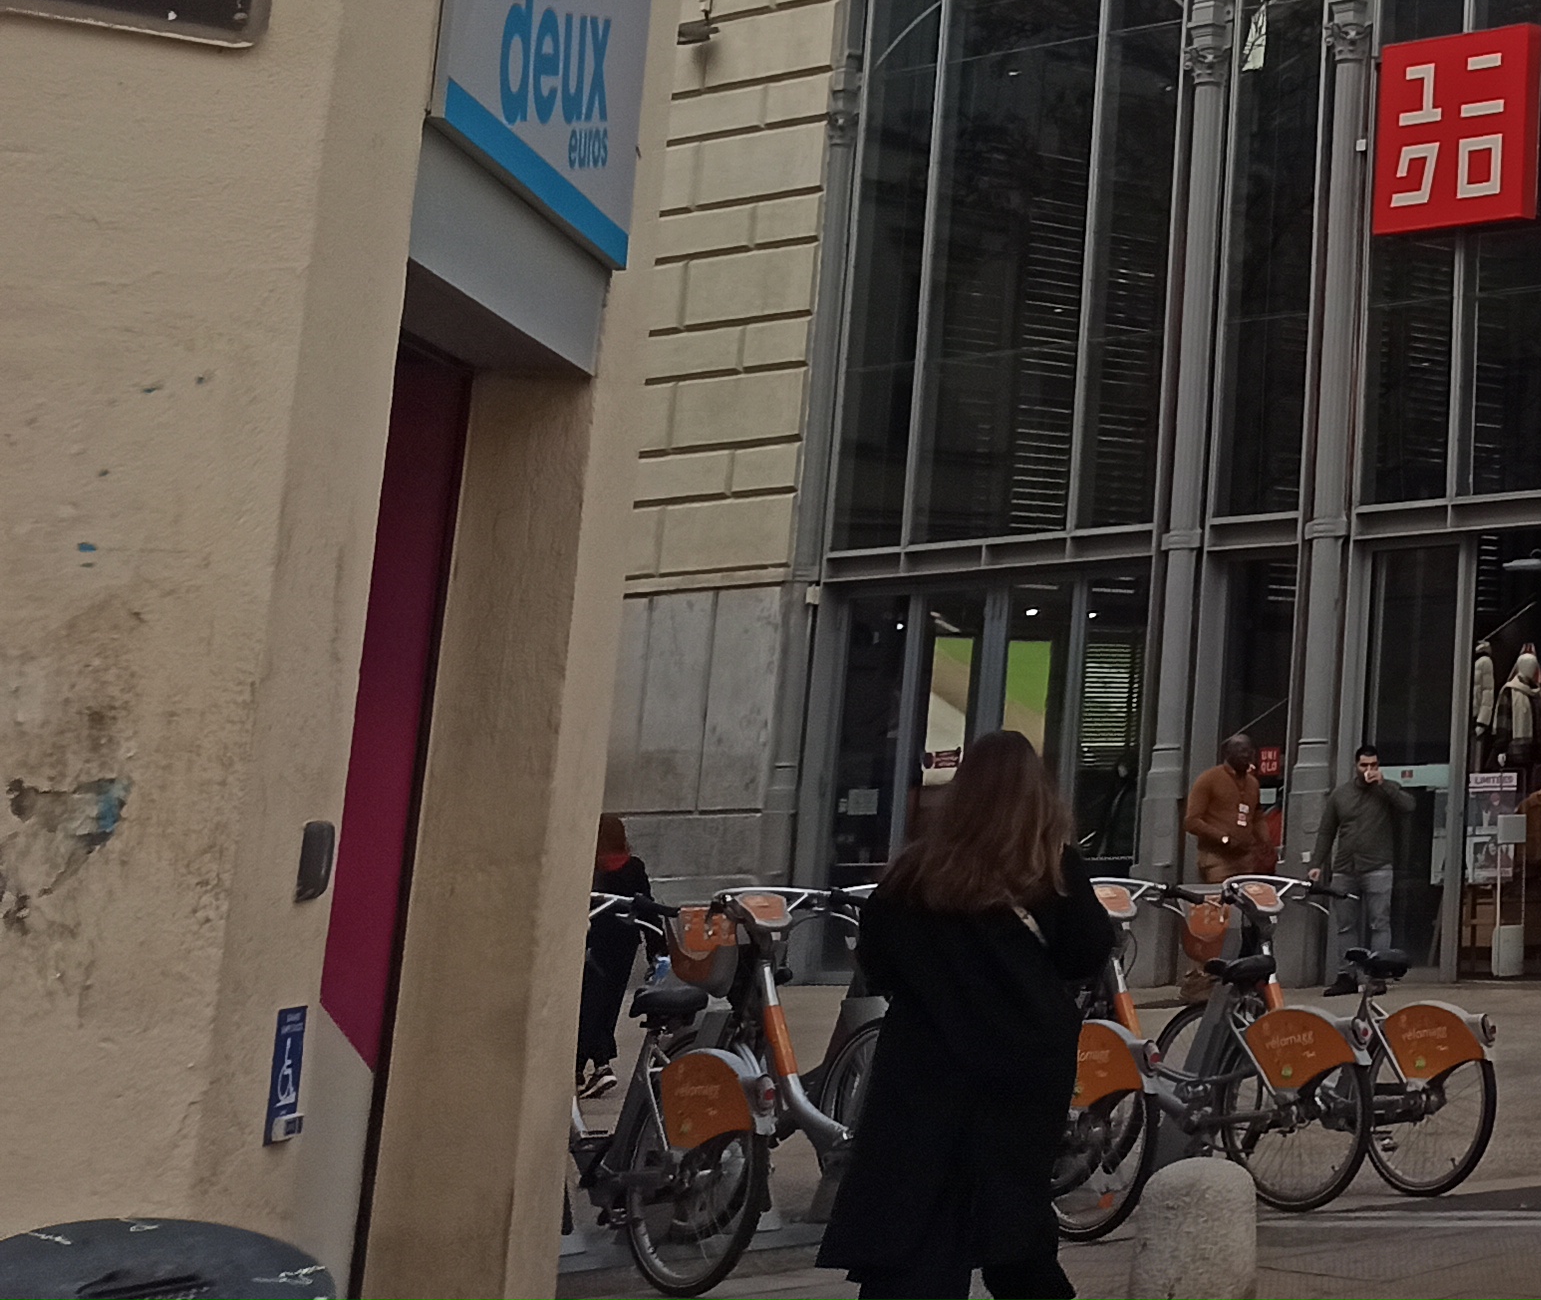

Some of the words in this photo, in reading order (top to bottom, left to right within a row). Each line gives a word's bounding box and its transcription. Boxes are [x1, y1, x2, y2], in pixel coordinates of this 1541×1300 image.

[567, 127, 609, 170] euros
[1260, 750, 1278, 761] UNI
[1260, 761, 1278, 774] QLO
